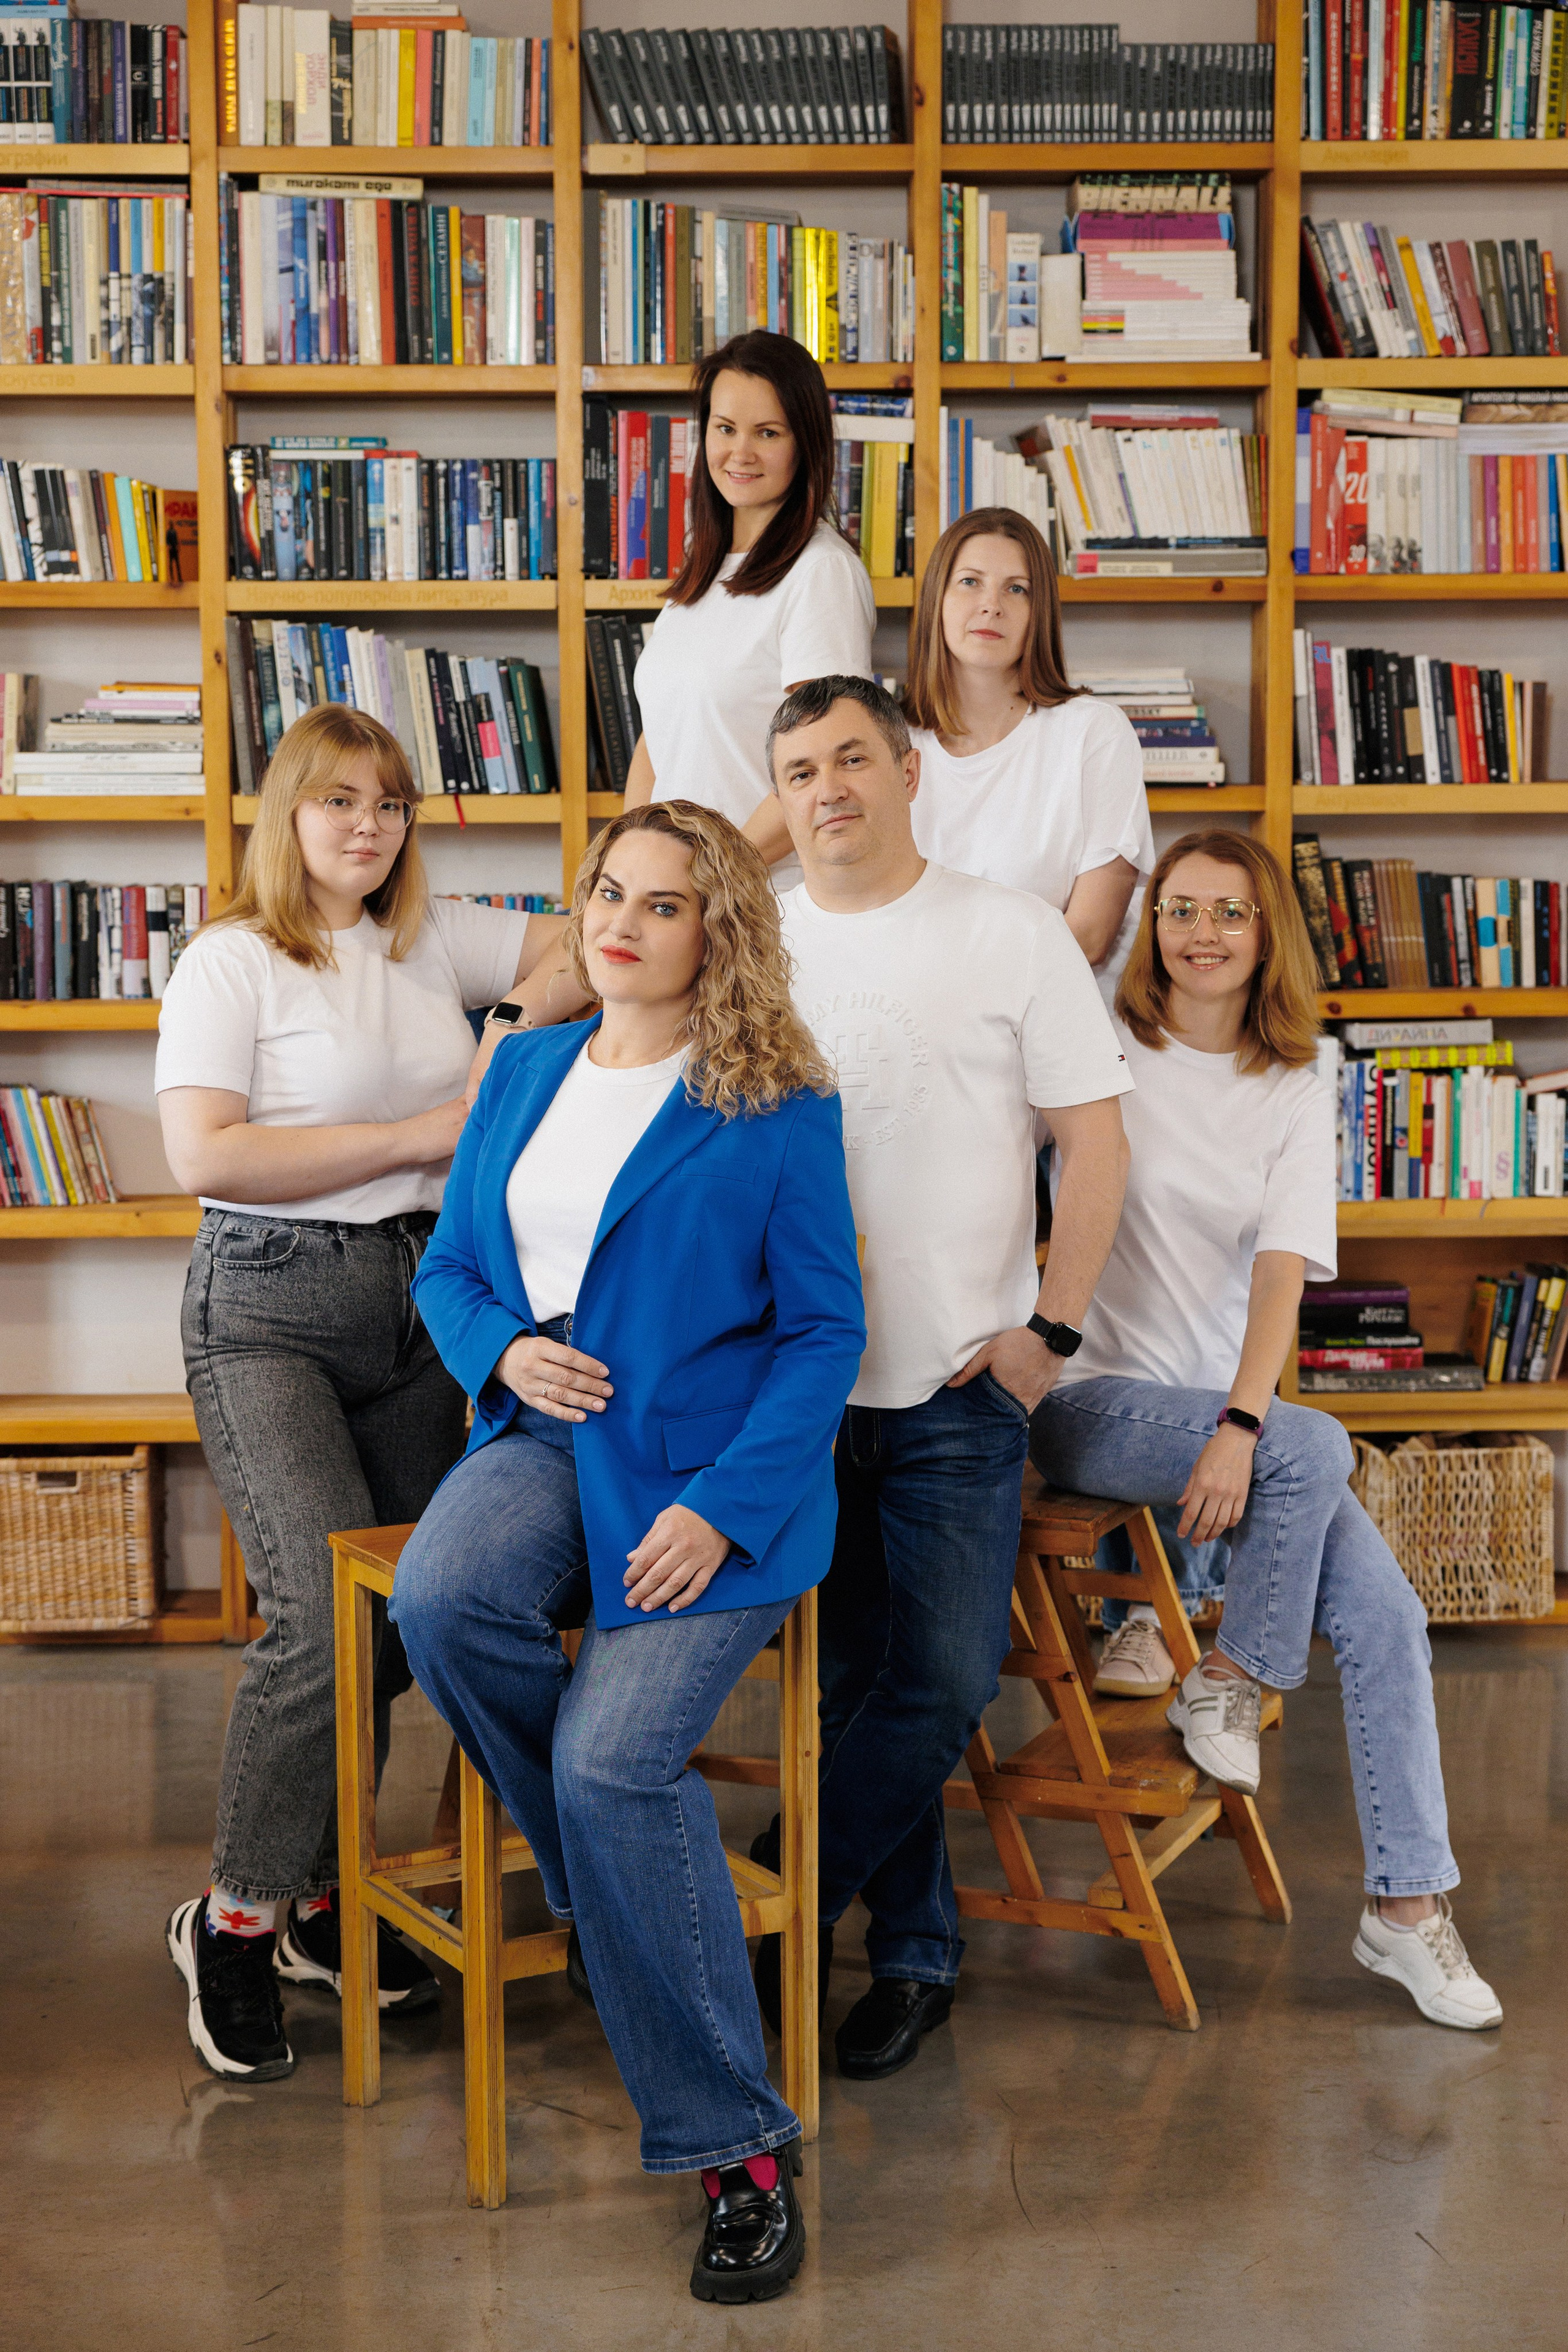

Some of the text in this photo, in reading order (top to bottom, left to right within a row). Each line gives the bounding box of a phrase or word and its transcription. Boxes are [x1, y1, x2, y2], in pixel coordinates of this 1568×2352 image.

[306, 53, 317, 105] УОРХОЛ
[317, 53, 327, 89] ЭНДИ
[285, 177, 360, 190] murakami
[1079, 185, 1232, 213] BIENNALE
[407, 206, 421, 306] FRIDA KAHLO
[436, 213, 448, 265] СЕЗАНН
[416, 588, 508, 606] литертура
[849, 991, 930, 1068] HILFIGER
[1366, 1025, 1448, 1044] ДИЗАЙНА
[903, 1083, 929, 1118] 1985
